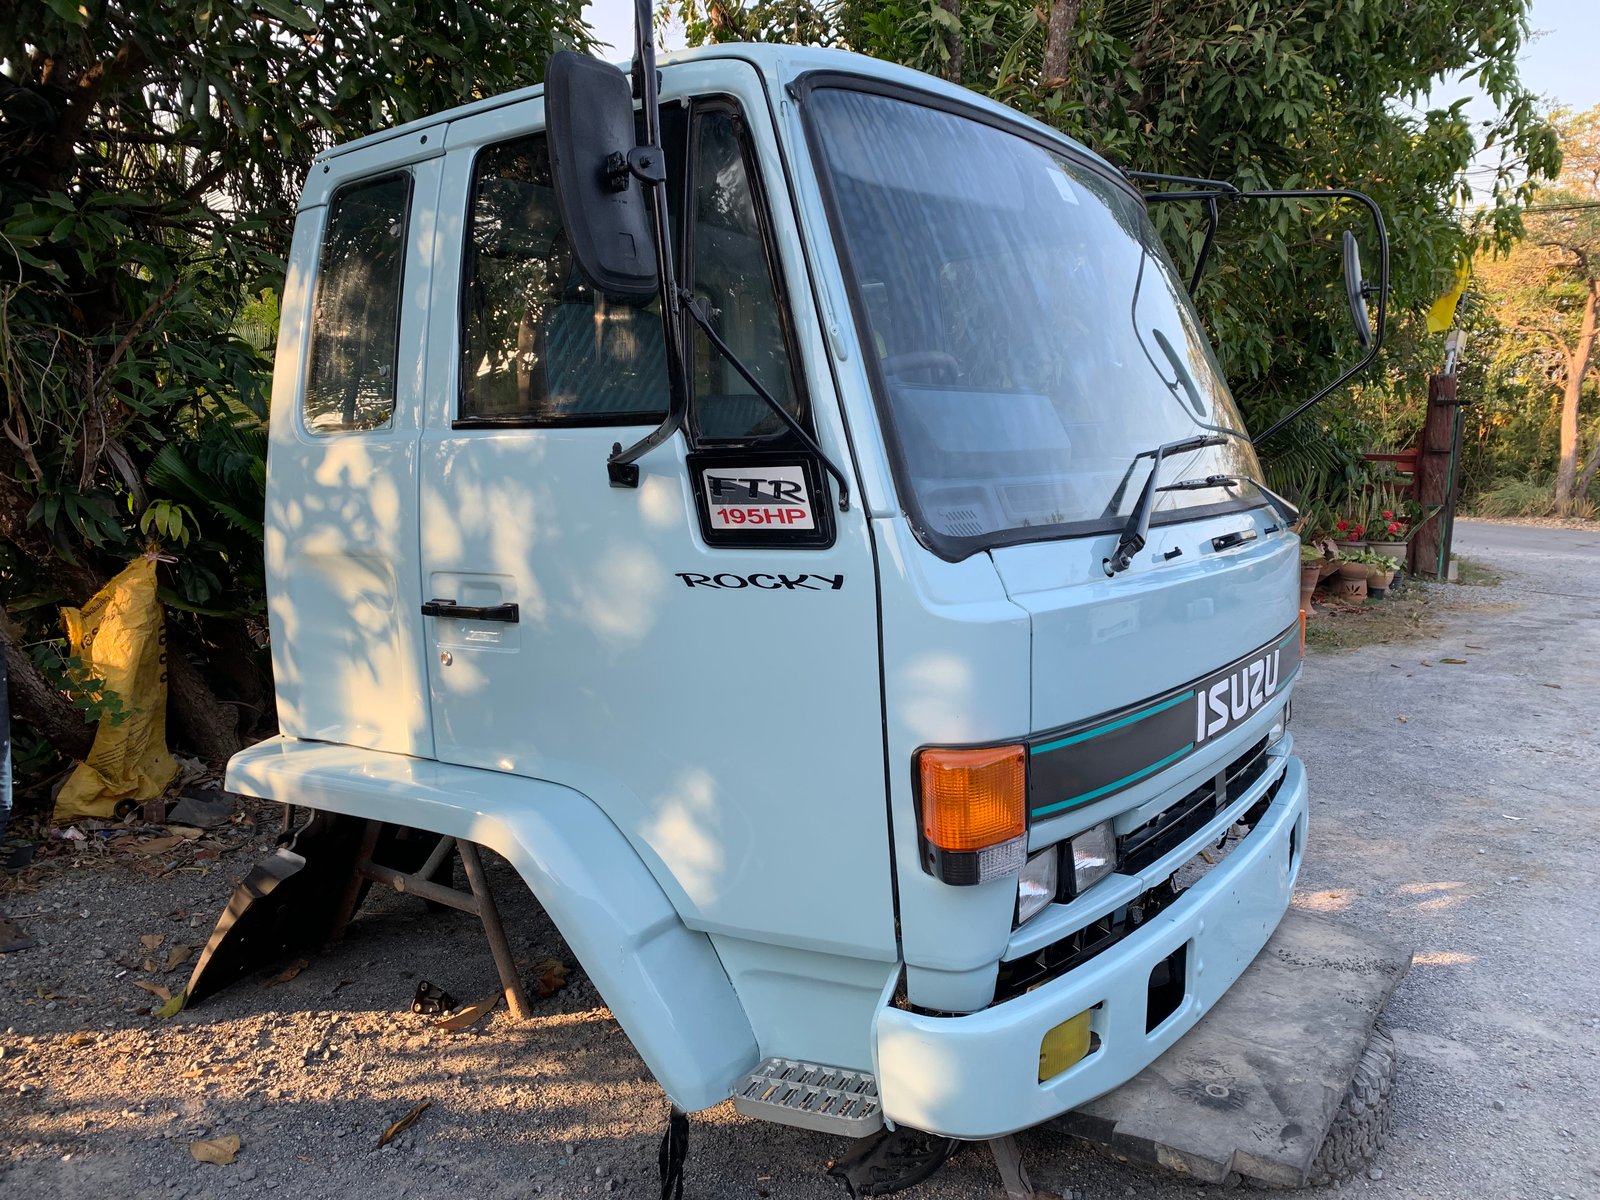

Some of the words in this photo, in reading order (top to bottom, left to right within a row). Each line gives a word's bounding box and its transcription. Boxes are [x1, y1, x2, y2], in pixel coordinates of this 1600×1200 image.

[706, 475, 806, 502] FTR
[717, 508, 806, 524] 195HP
[674, 573, 844, 590] ROCKY
[1197, 649, 1280, 742] ISUZU
